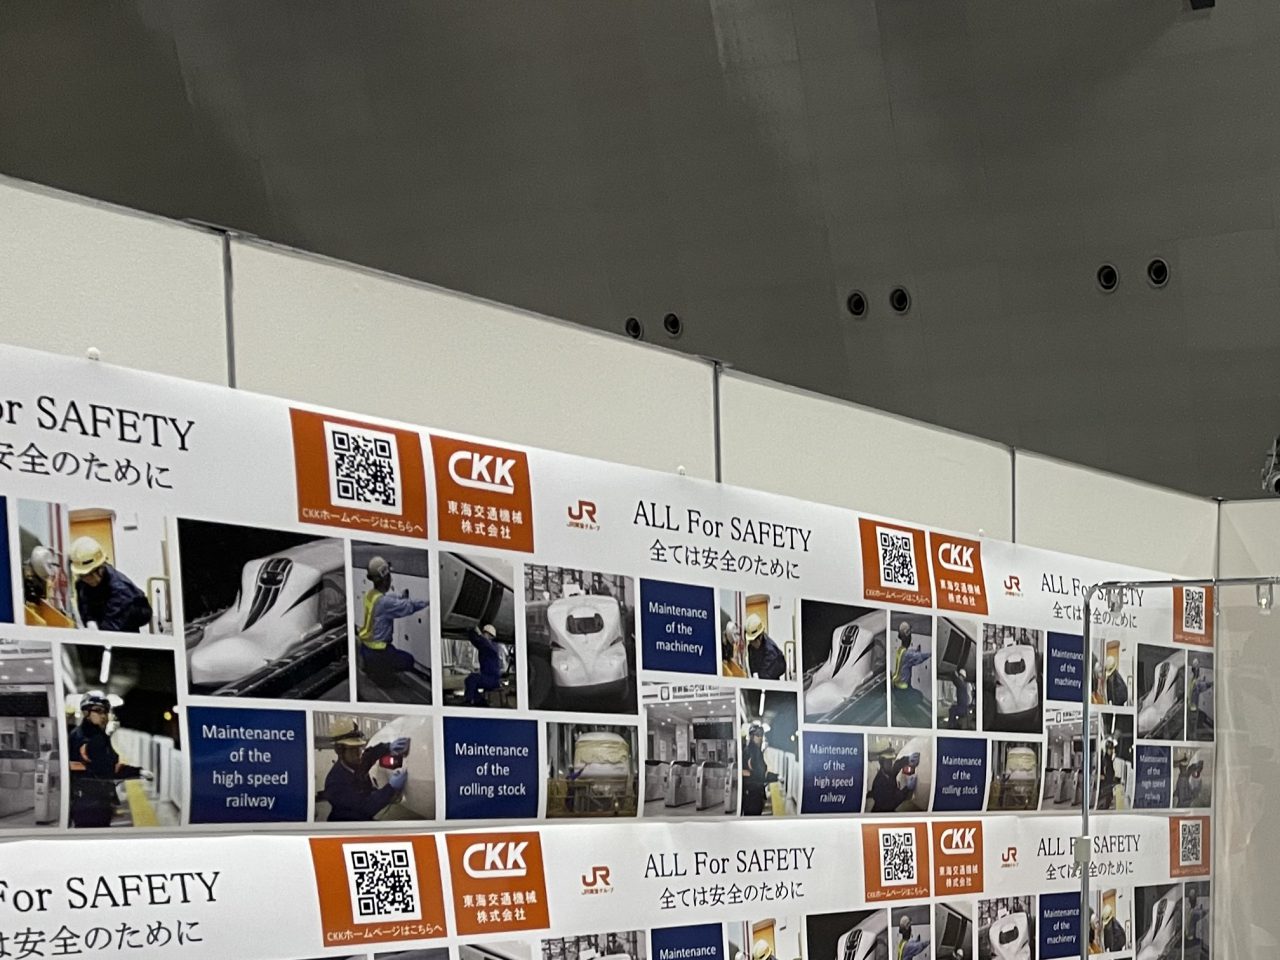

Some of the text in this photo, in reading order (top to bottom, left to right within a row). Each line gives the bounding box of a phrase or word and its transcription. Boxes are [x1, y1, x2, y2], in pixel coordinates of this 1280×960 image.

[36, 395, 195, 451] SAFETY
[448, 450, 516, 495] CKK
[567, 500, 597, 523] JR
[461, 519, 512, 541] 株式会社
[633, 499, 812, 552] ALL For SAFETY
[649, 538, 800, 580] 全ては安全のために
[938, 542, 974, 574] CKK
[1004, 575, 1021, 592] JR
[1041, 573, 1069, 595] ALL
[648, 601, 708, 619] Maintenance
[665, 621, 693, 636] of the
[656, 639, 703, 657] machinery
[1051, 647, 1084, 660] Maintenanc
[203, 724, 295, 741] Maintenance
[229, 749, 271, 763] of the
[455, 742, 528, 758] Maintenance
[809, 743, 858, 757] Maintenance
[476, 763, 510, 777] of the
[823, 759, 845, 771] of the
[942, 755, 982, 768] Maintenance
[212, 770, 288, 789] high speed
[814, 775, 853, 789] high speed
[952, 770, 971, 781] of the
[459, 782, 526, 798] rolling stock
[820, 791, 846, 804] railway
[941, 783, 978, 797] rolling stock
[225, 793, 276, 810] railway
[940, 828, 977, 855] CKK
[1037, 837, 1065, 857] ALL
[1093, 834, 1141, 854] SAFETY
[462, 841, 529, 878] CKK
[644, 847, 815, 878] ALL For SAFETY
[1001, 847, 1018, 863] JR
[581, 866, 610, 887] JR
[66, 871, 220, 910] SAFETY
[659, 880, 805, 910] 全ては安全のために
[476, 906, 526, 924] 株式会社
[326, 924, 443, 942] CKKホームページはこちらへ
[659, 944, 717, 960] Maintenance
